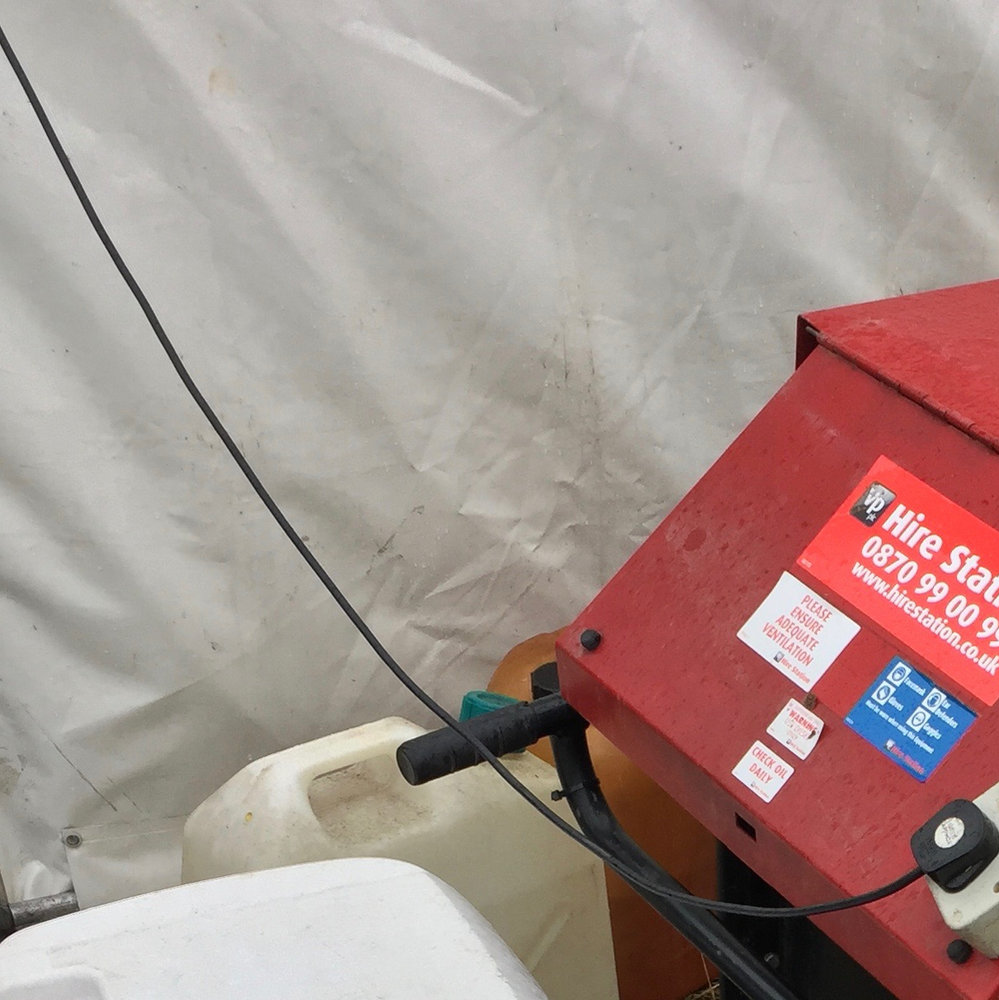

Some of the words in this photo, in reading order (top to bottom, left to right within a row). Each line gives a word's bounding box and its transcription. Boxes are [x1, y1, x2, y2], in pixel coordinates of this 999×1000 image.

[881, 503, 943, 560] Hire
[861, 535, 919, 584] 0870
[914, 573, 949, 604] 99
[945, 595, 980, 627] 00
[790, 606, 824, 635] ENSURE
[801, 594, 833, 622] PLEASE
[762, 622, 814, 667] VENTILATION
[775, 615, 819, 652] ADEQUATE
[749, 763, 773, 784] DAILY
[752, 746, 777, 769] CHECK
[774, 763, 788, 779] OIL
